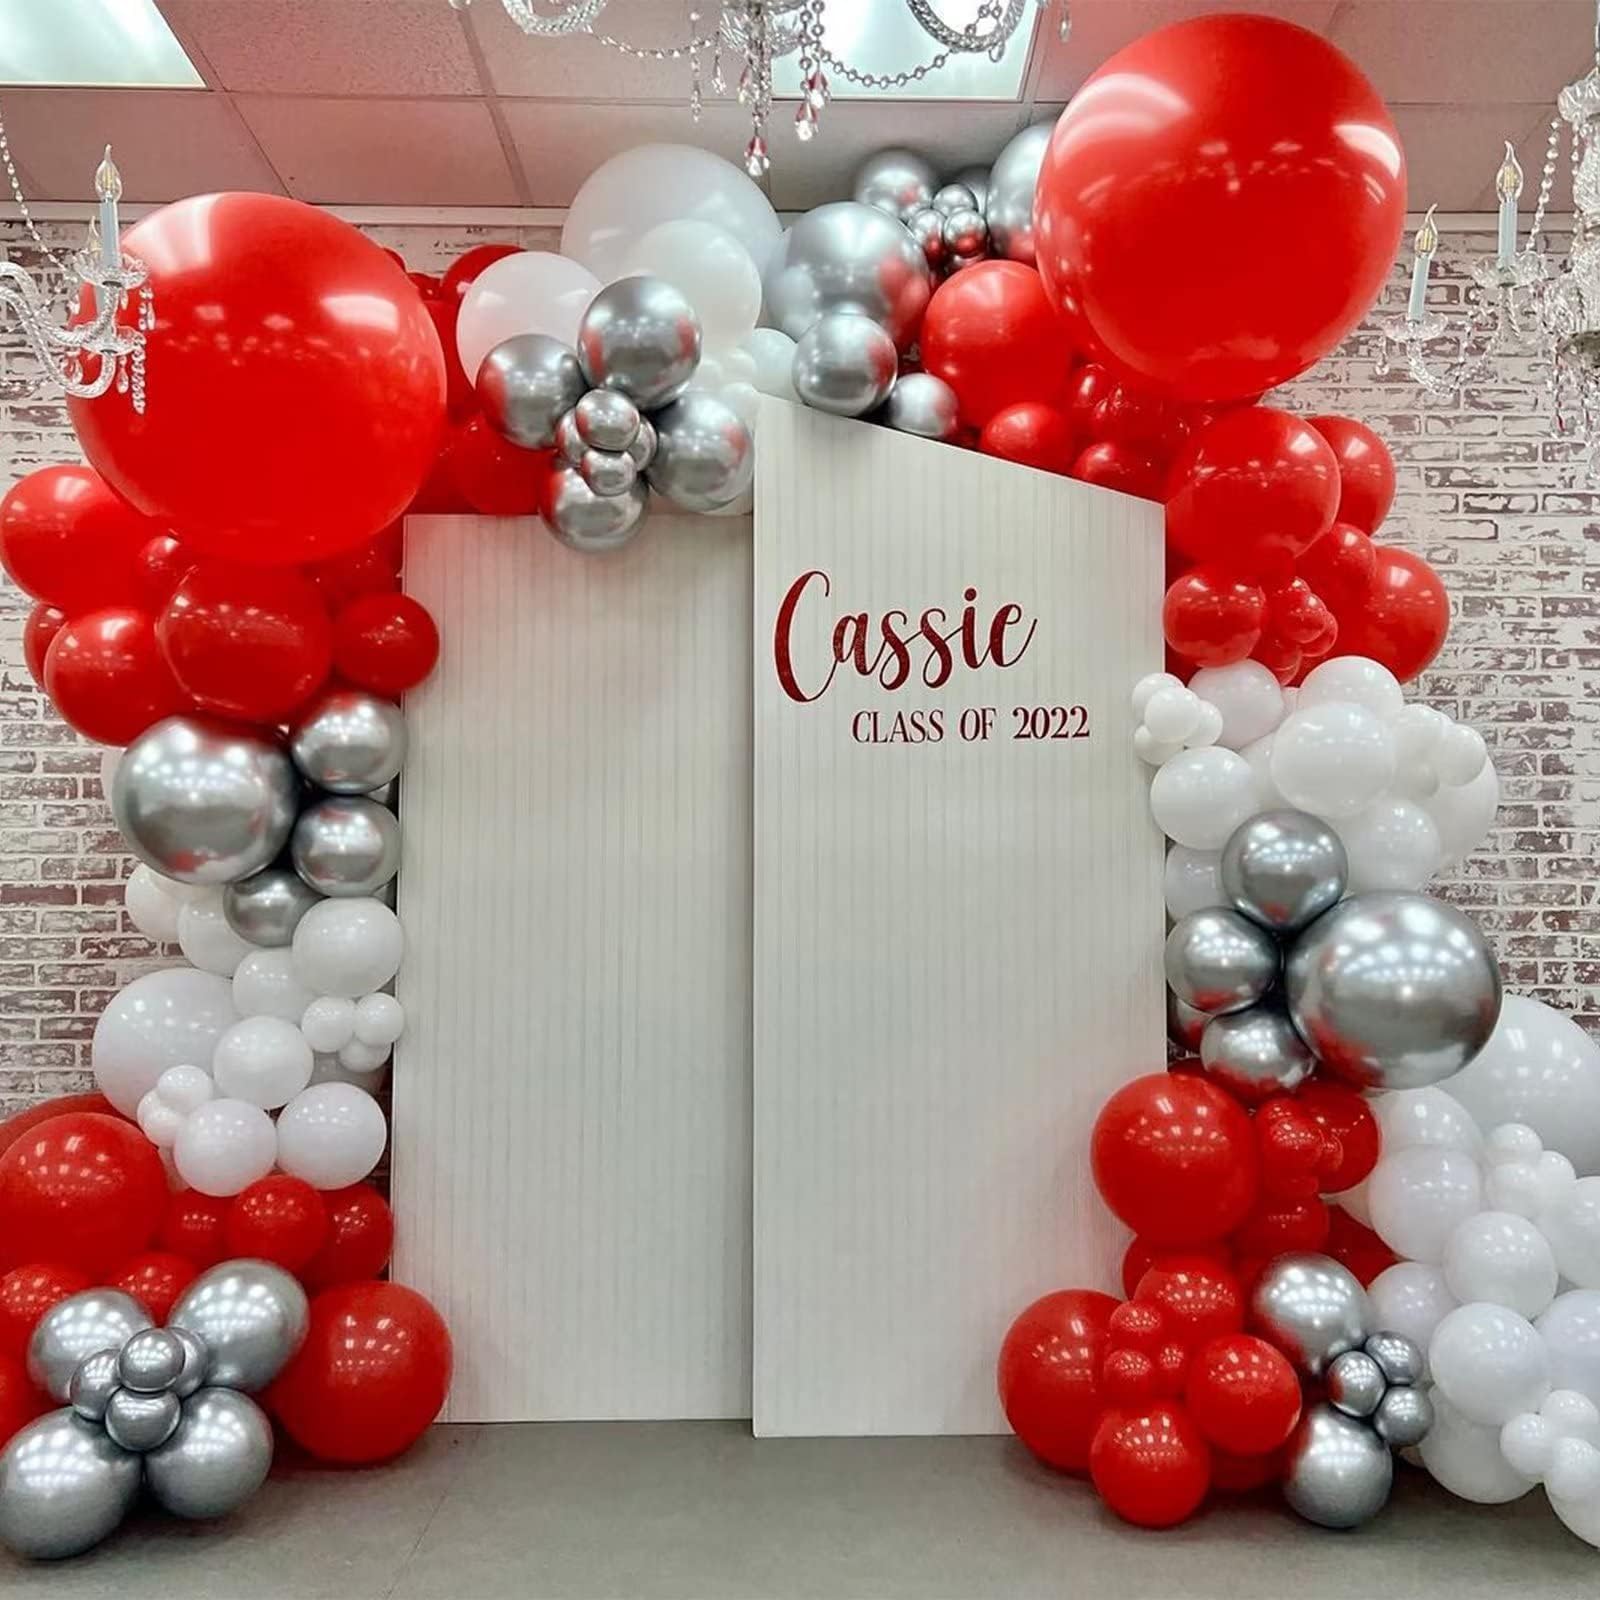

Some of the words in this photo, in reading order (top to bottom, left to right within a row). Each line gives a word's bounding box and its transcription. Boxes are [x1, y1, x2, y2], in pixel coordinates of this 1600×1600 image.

[774, 570, 1037, 702] Cassie
[852, 710, 944, 743] CLASS
[960, 708, 996, 741] OF
[1012, 706, 1090, 739] 2022
